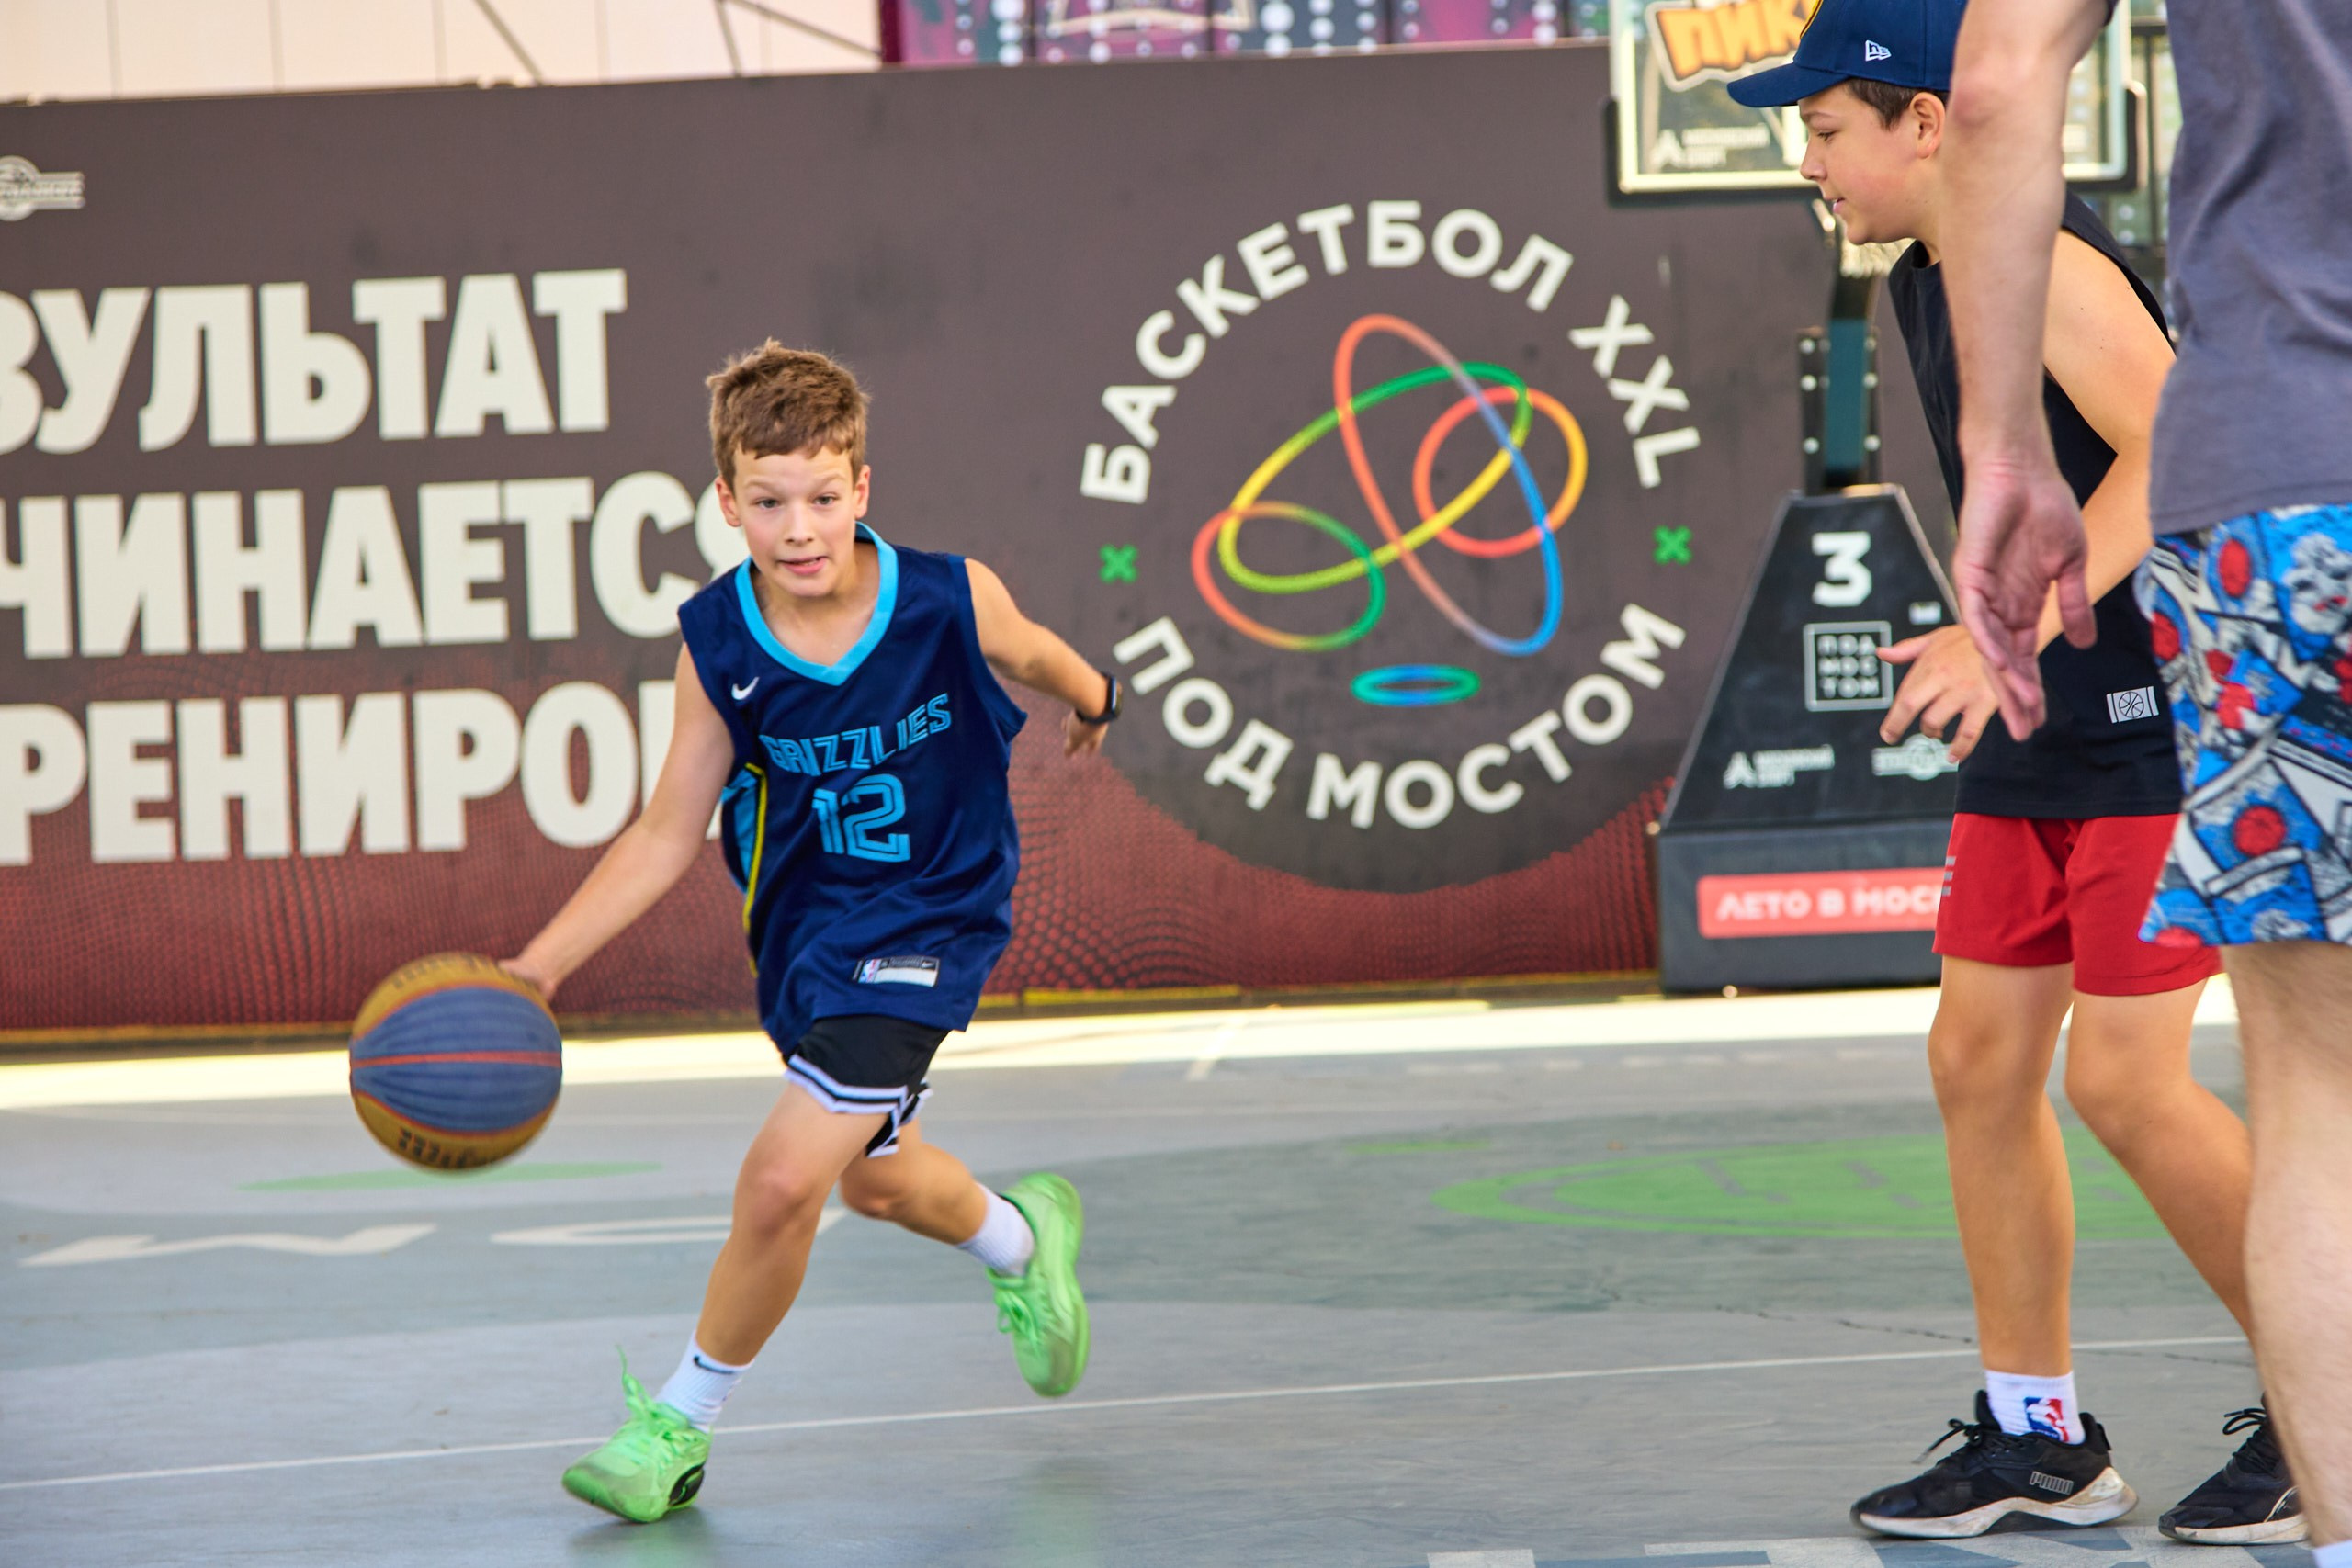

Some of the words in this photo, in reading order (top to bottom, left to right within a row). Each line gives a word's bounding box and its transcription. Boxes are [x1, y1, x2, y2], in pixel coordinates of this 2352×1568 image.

[1656, 0, 1808, 80] ПИК
[1080, 199, 1574, 505] БАСКЕТБОЛ
[1567, 294, 1702, 489] XXL
[1812, 531, 1872, 608] 3
[759, 693, 952, 777] GRIZZLIES
[1112, 616, 1294, 811] ПОД
[1306, 603, 1687, 829] МОСТОМ
[811, 773, 911, 863] 12
[1716, 888, 1812, 921] ЛЕТО
[1816, 887, 1845, 918] В
